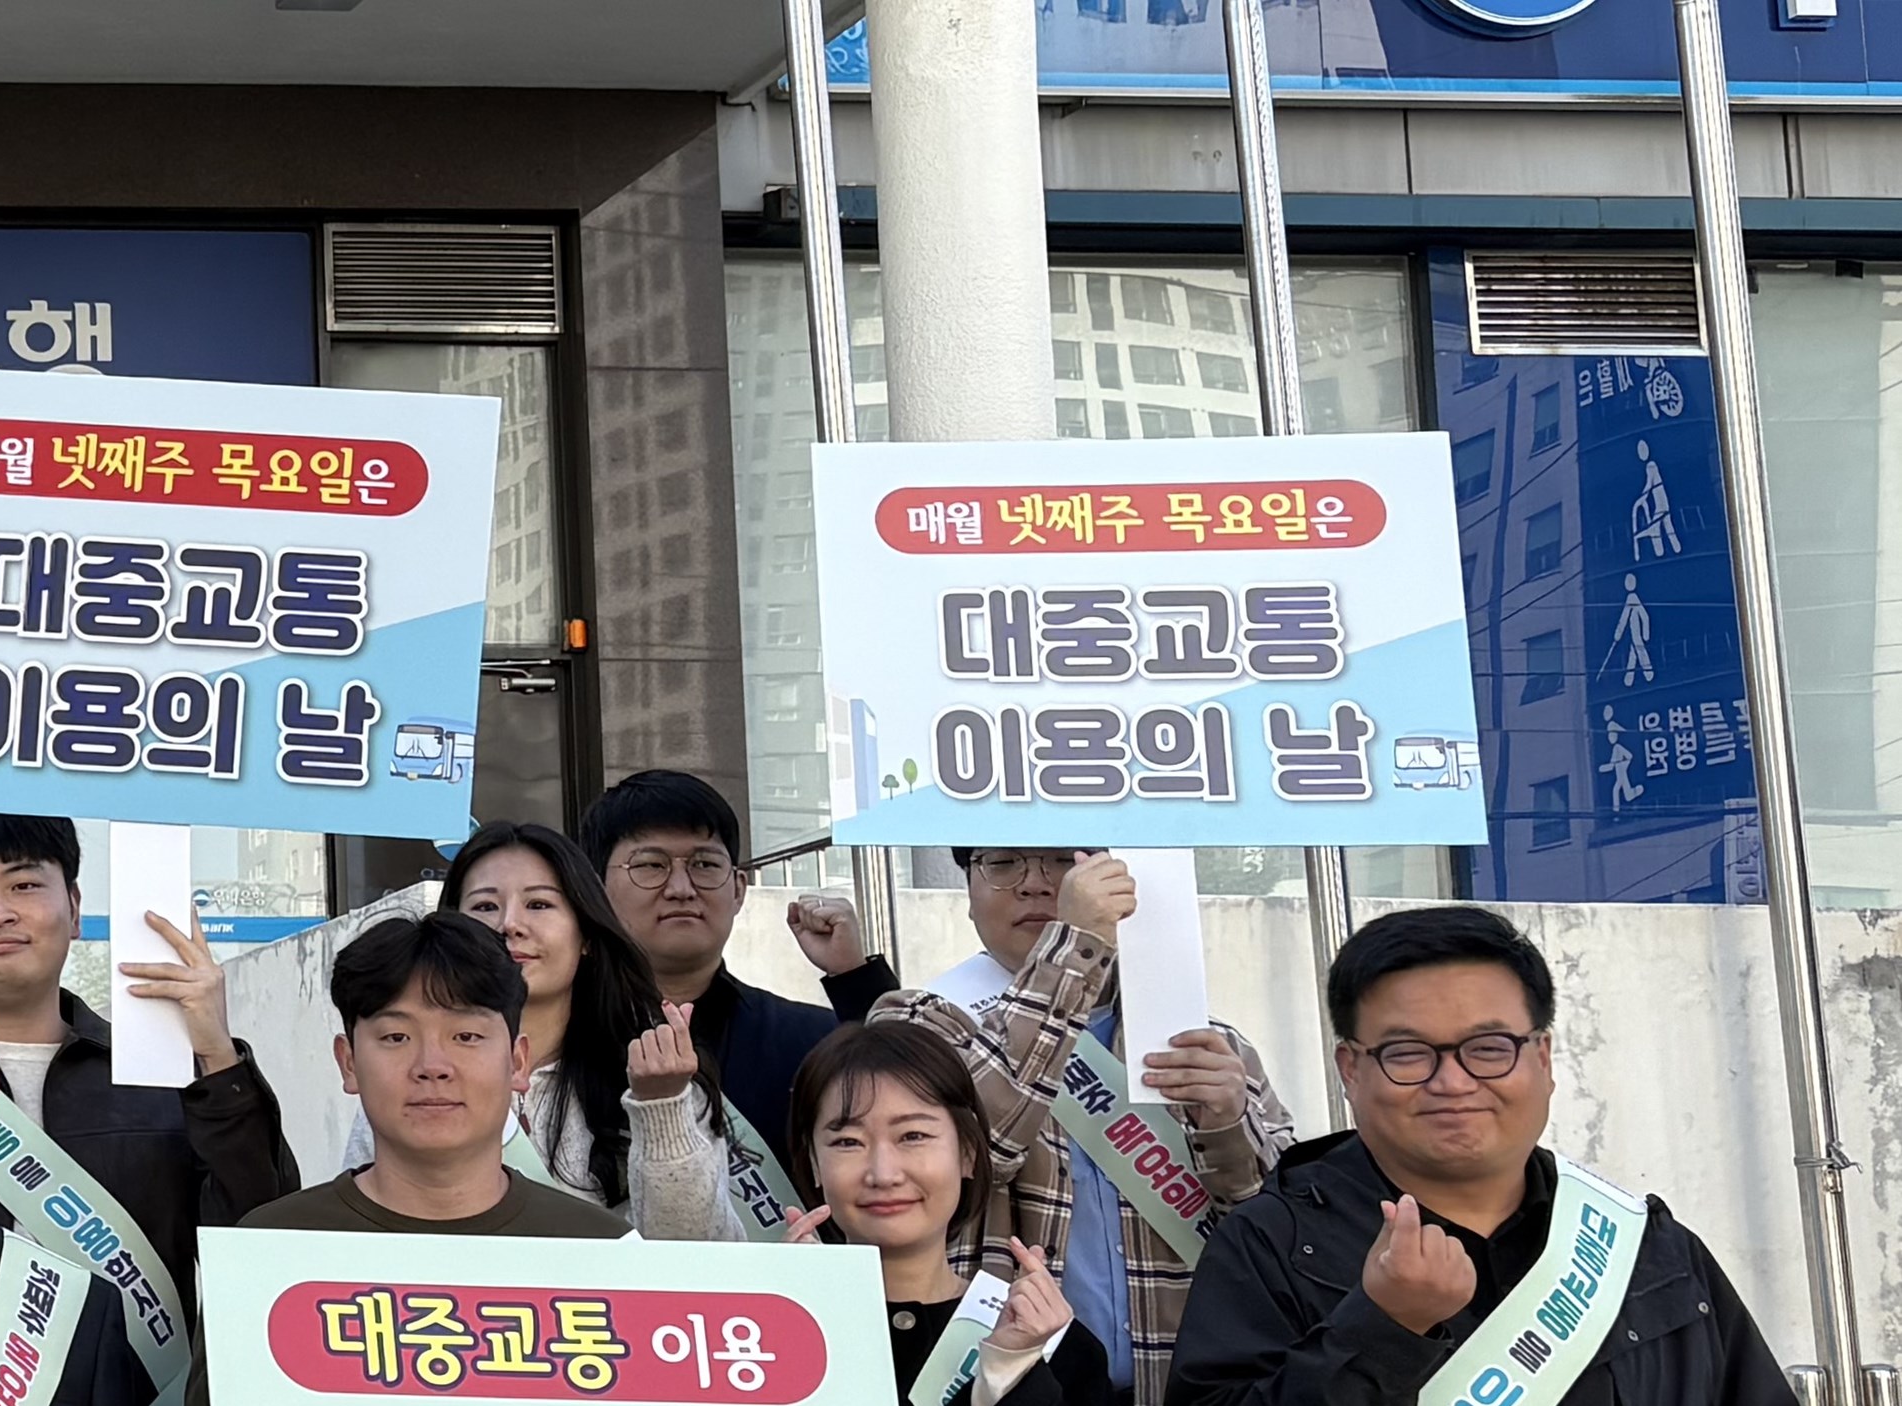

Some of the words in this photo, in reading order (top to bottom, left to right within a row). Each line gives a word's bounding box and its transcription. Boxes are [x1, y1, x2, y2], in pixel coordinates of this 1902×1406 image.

[50, 432, 196, 497] 넷째주
[211, 441, 397, 508] 목요일은
[905, 502, 983, 547] 매월
[997, 490, 1145, 550] 넷째주
[1162, 487, 1353, 545] 목요일은
[938, 580, 1346, 684] 대중교통
[277, 676, 382, 789] 날
[931, 701, 1235, 803] 이용의
[1265, 698, 1376, 802] 날
[1104, 1112, 1210, 1220] 목요일
[17, 1259, 62, 1336] 넷째주
[42, 1185, 174, 1348] 이용합시다
[317, 1291, 629, 1395] 대중교통
[651, 1312, 776, 1395] 이용
